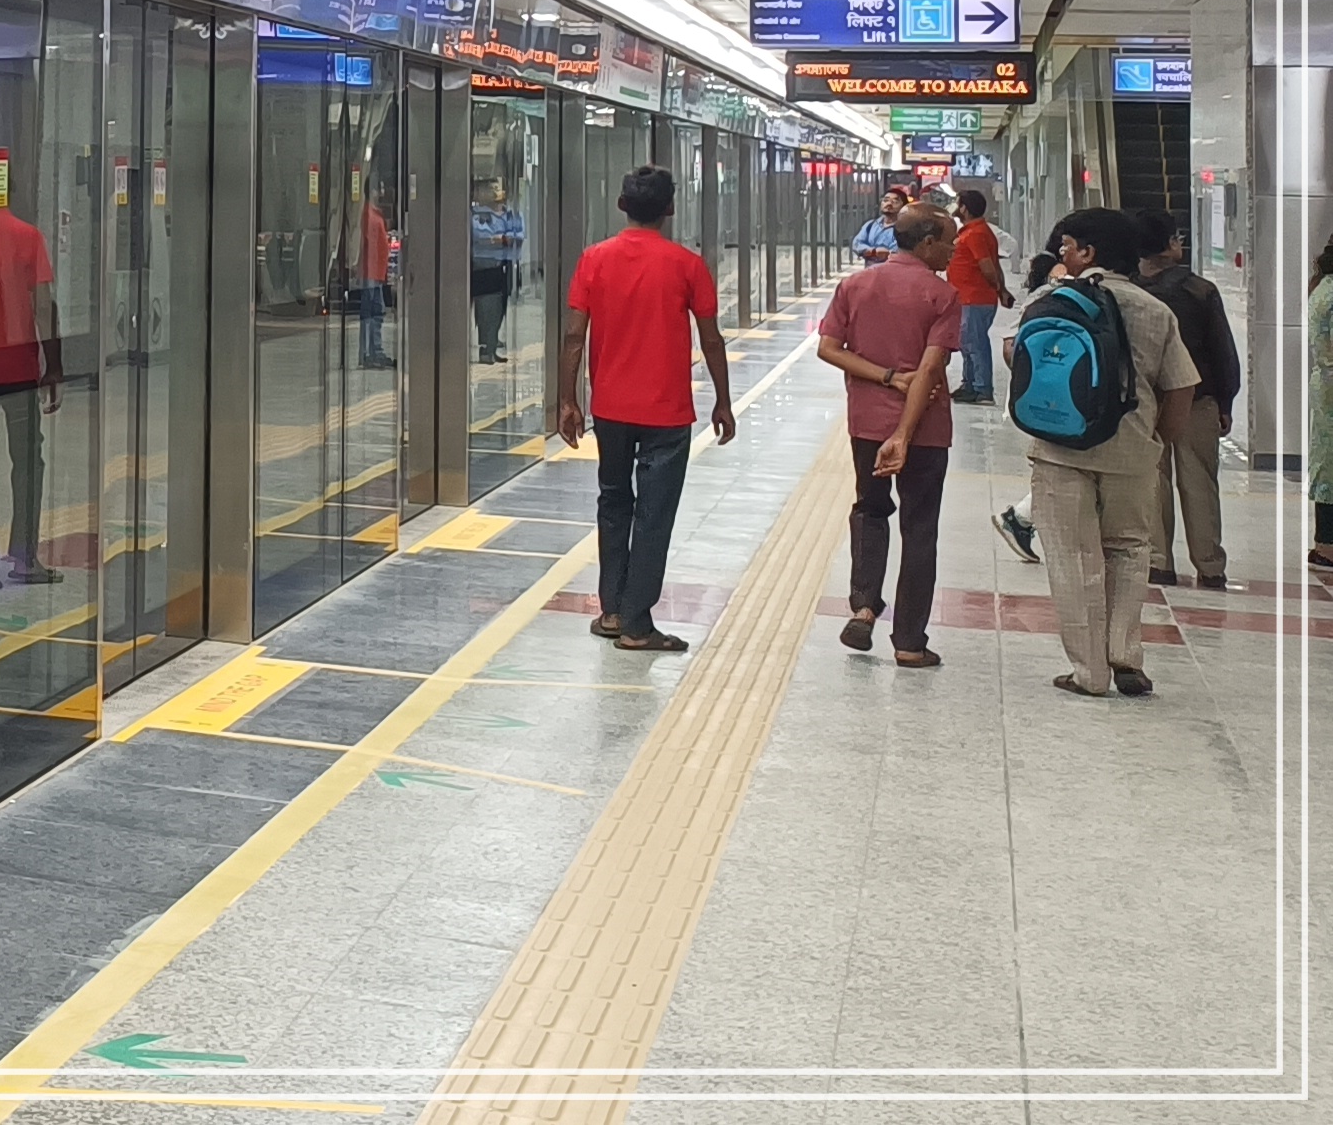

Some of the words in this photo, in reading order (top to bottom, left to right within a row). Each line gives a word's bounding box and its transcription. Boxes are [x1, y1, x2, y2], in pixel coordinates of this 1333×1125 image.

[863, 31, 886, 43] Lift
[889, 31, 896, 42] 1
[996, 63, 1016, 77] 02
[827, 79, 917, 94] WELCOME
[920, 79, 945, 94] TO
[948, 79, 1028, 94] MAHAKA
